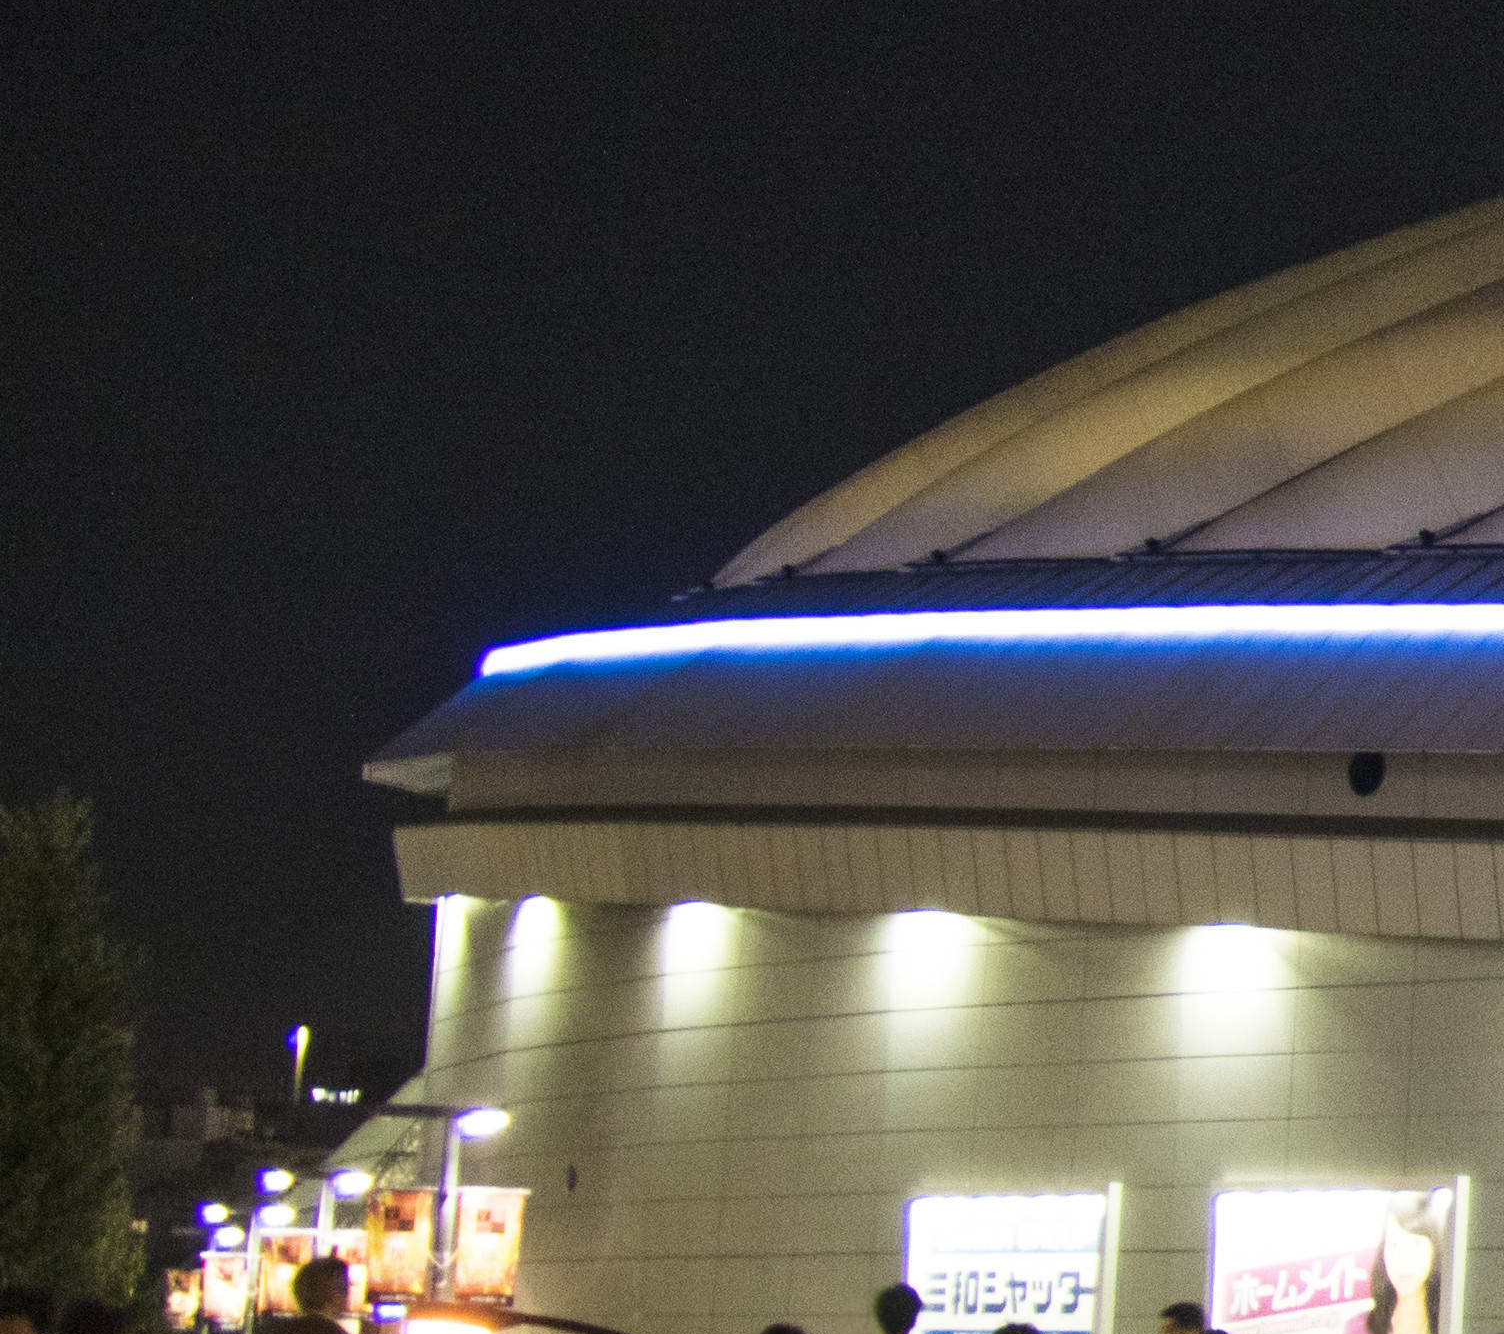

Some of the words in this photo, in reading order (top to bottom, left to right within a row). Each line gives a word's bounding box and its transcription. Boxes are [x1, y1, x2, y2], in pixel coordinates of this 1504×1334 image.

[922, 1271, 1097, 1315] 三和シャッター
[1230, 1255, 1368, 1316] ホームメイト
